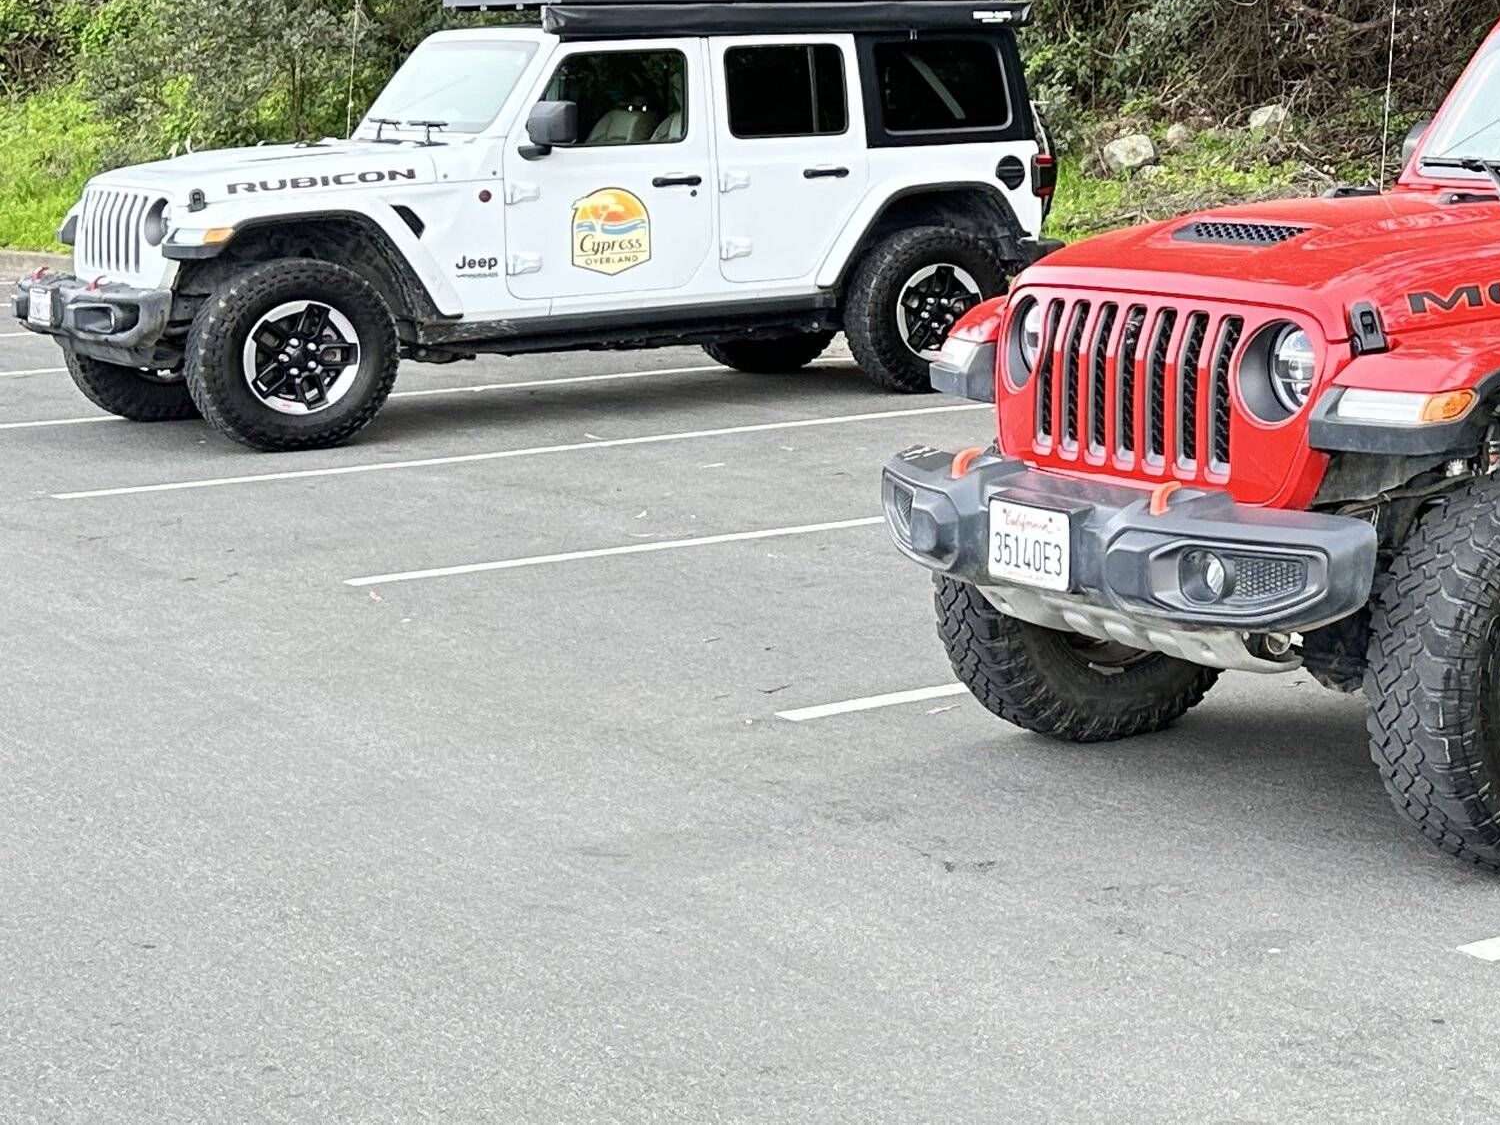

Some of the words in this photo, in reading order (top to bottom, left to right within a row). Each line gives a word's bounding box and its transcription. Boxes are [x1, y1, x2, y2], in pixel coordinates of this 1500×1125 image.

[226, 168, 417, 195] RUBICON
[579, 233, 642, 255] Cypress
[455, 255, 498, 270] Jeep
[585, 255, 639, 266] OVERLAND
[994, 530, 1063, 577] 35140E3
